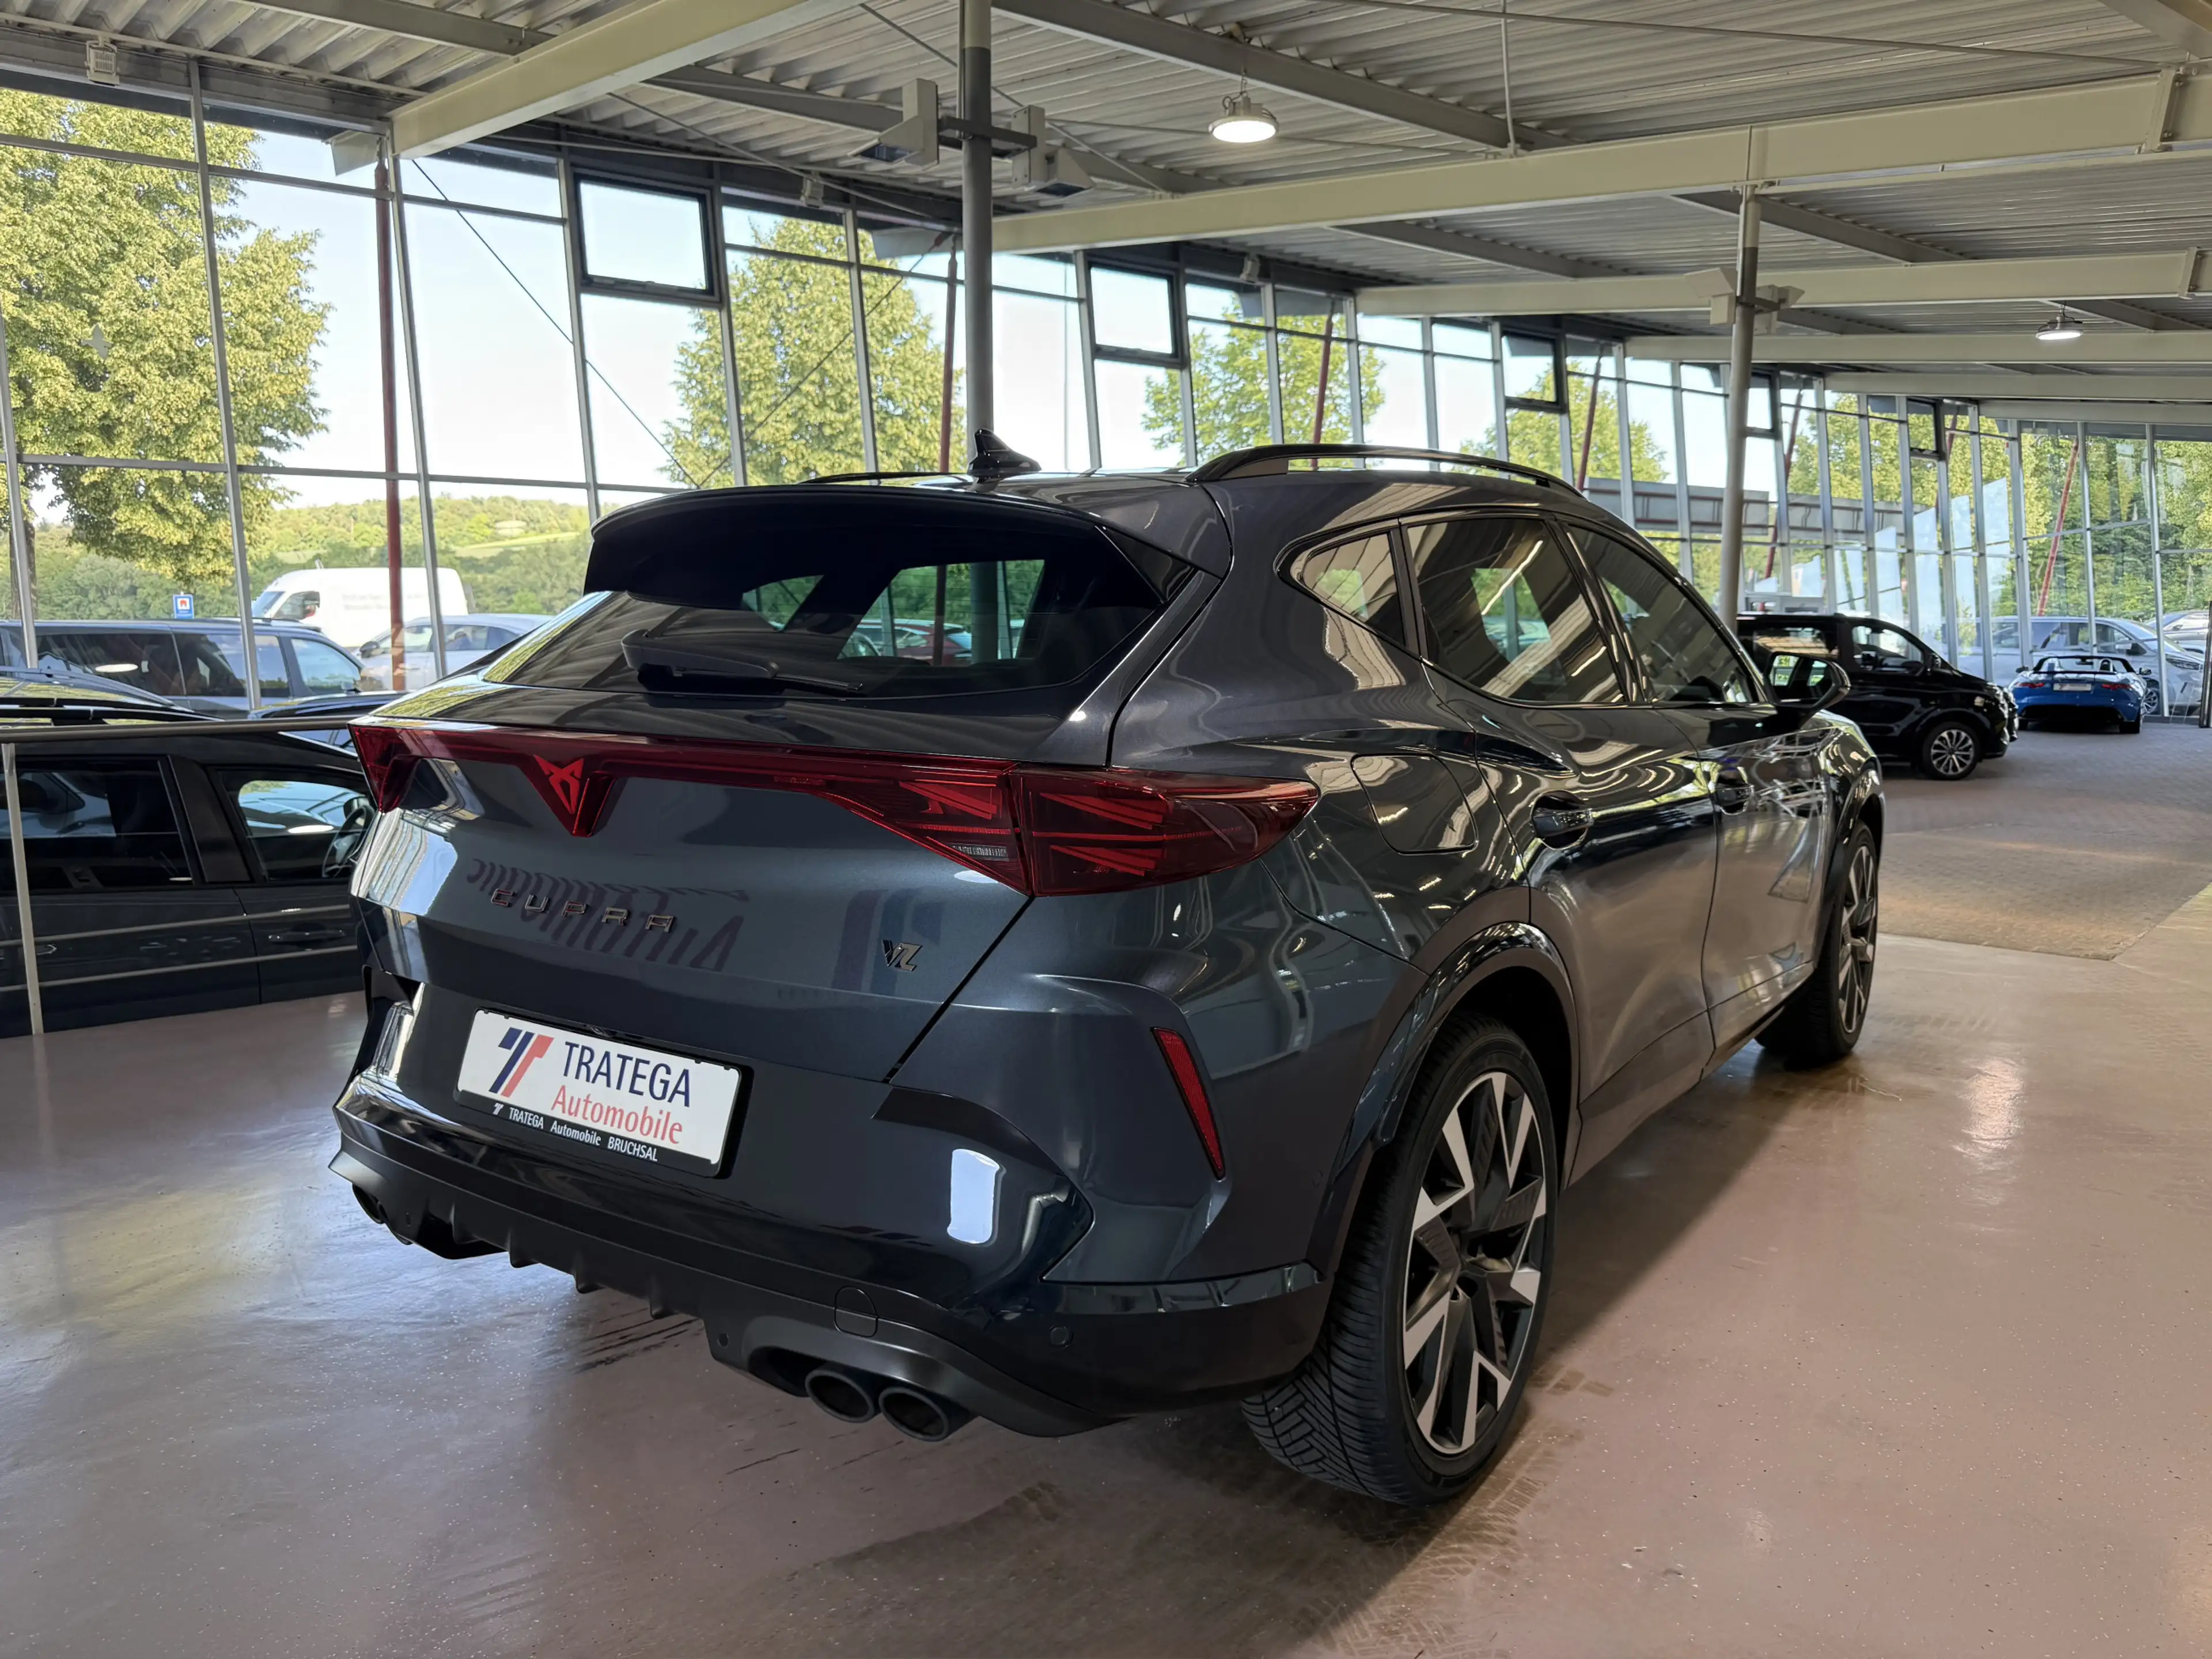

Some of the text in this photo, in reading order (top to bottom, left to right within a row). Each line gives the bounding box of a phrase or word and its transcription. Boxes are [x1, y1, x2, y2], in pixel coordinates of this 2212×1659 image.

[490, 888, 676, 932] CUPRA
[881, 939, 923, 972] VZ
[563, 1041, 690, 1108] TRATEGA
[509, 1107, 658, 1162] TRATEGA Automobile BRUCHSAL
[551, 1085, 683, 1144] Automobile
